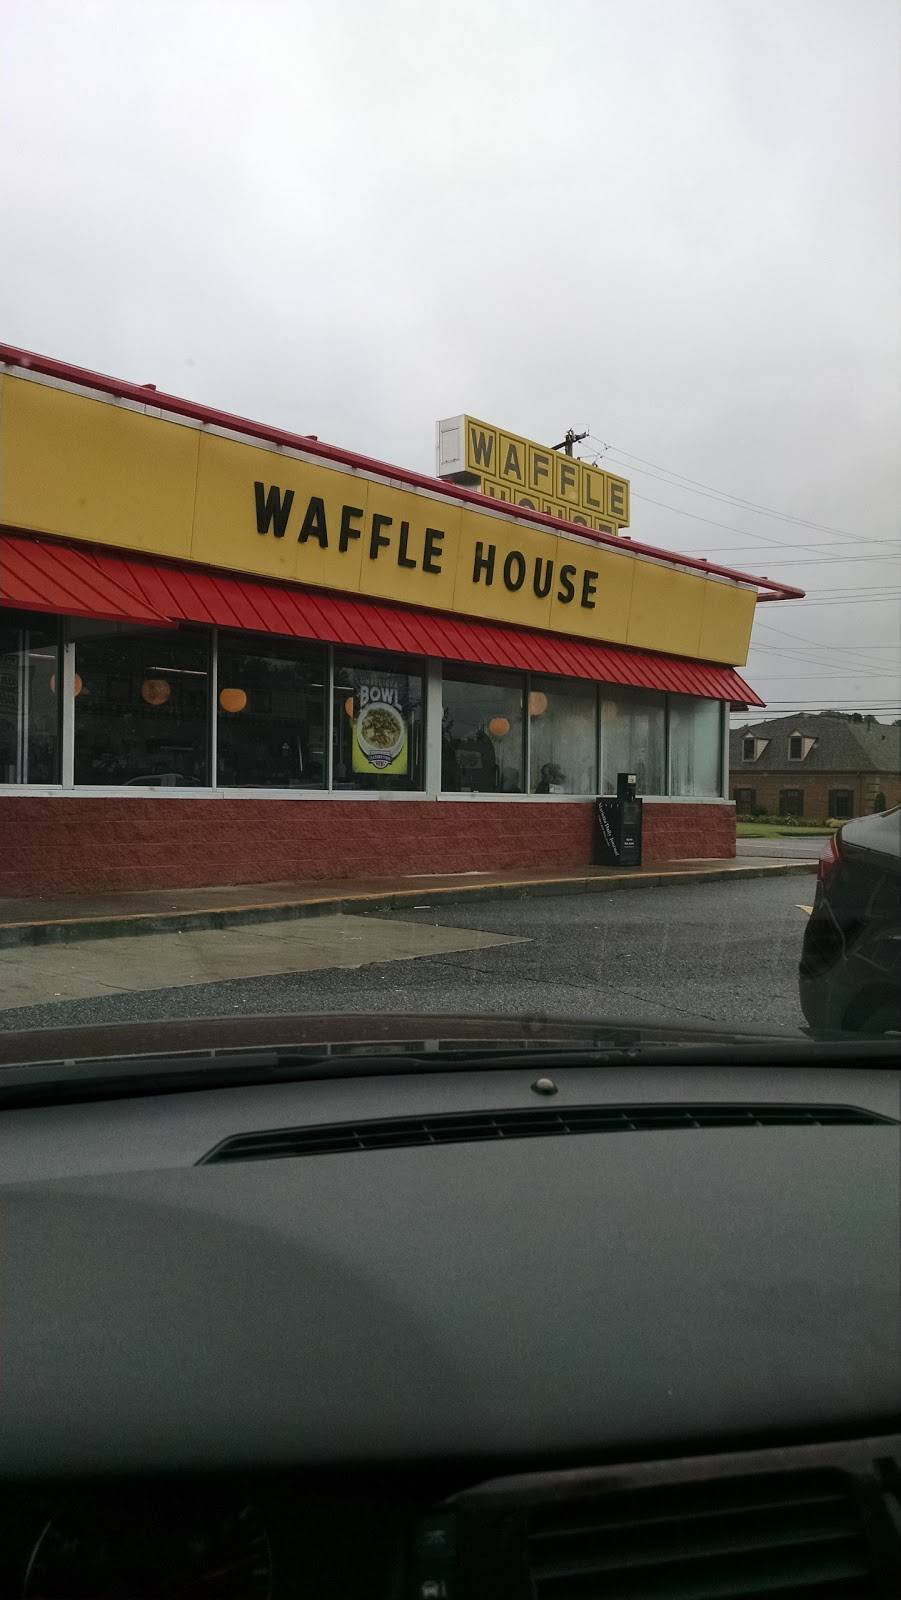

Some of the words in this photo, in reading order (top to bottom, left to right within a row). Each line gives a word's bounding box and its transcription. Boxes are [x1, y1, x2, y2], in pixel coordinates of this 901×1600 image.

[471, 428, 624, 516] WAFFLE
[253, 481, 445, 574] WAFFLE
[472, 541, 599, 609] HOUSE
